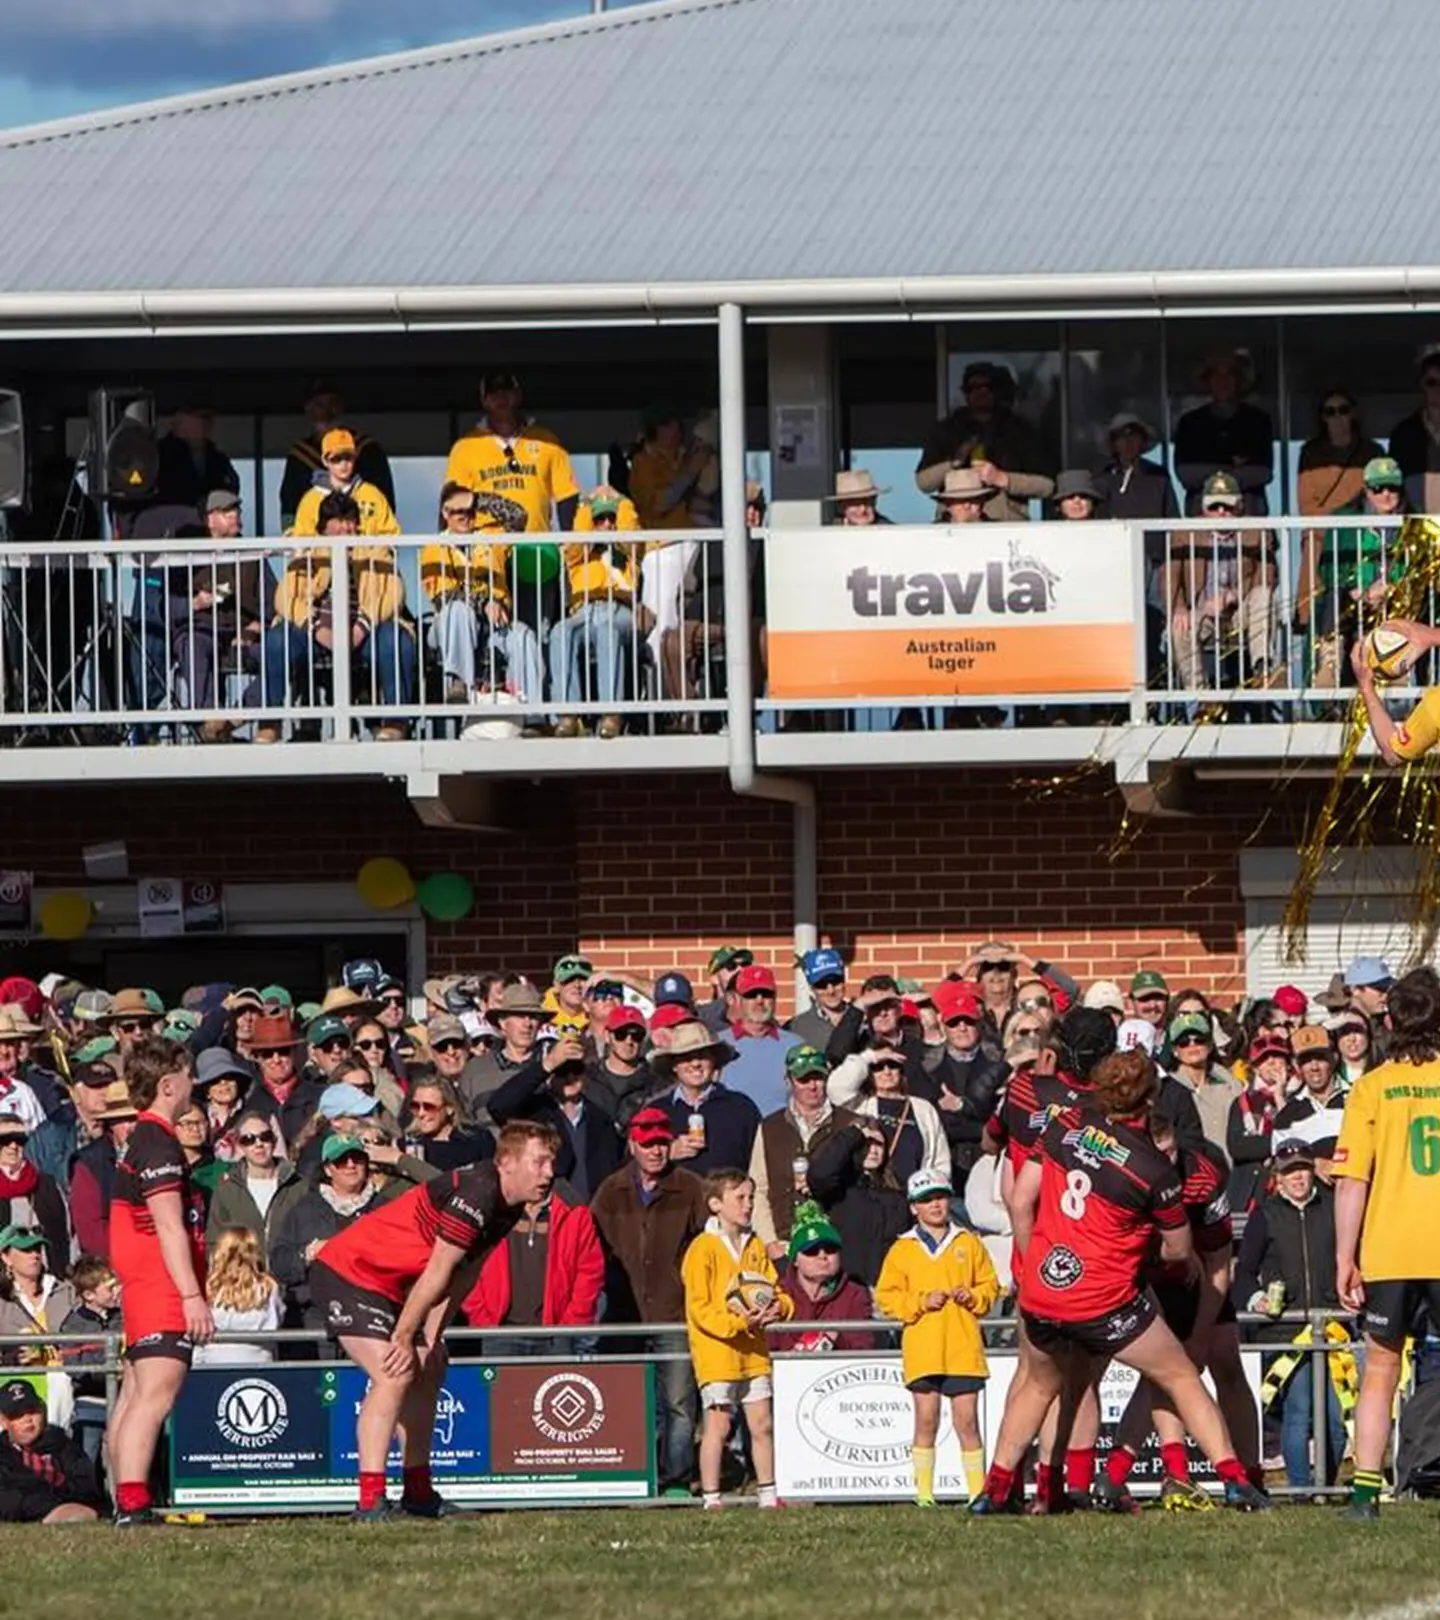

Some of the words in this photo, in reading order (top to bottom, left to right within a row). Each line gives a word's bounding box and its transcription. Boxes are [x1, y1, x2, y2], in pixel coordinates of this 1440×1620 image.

[847, 566, 1047, 617] travla
[905, 637, 997, 656] Australian
[927, 654, 975, 674] lager
[1060, 1169, 1092, 1221] 8
[235, 1394, 271, 1428] M
[838, 1401, 912, 1414] BOOROWA
[215, 1415, 290, 1448] MERRIGNEE
[531, 1412, 606, 1443] MERRIGNEE
[793, 1478, 815, 1490] and
[818, 1476, 890, 1489] BUILDING
